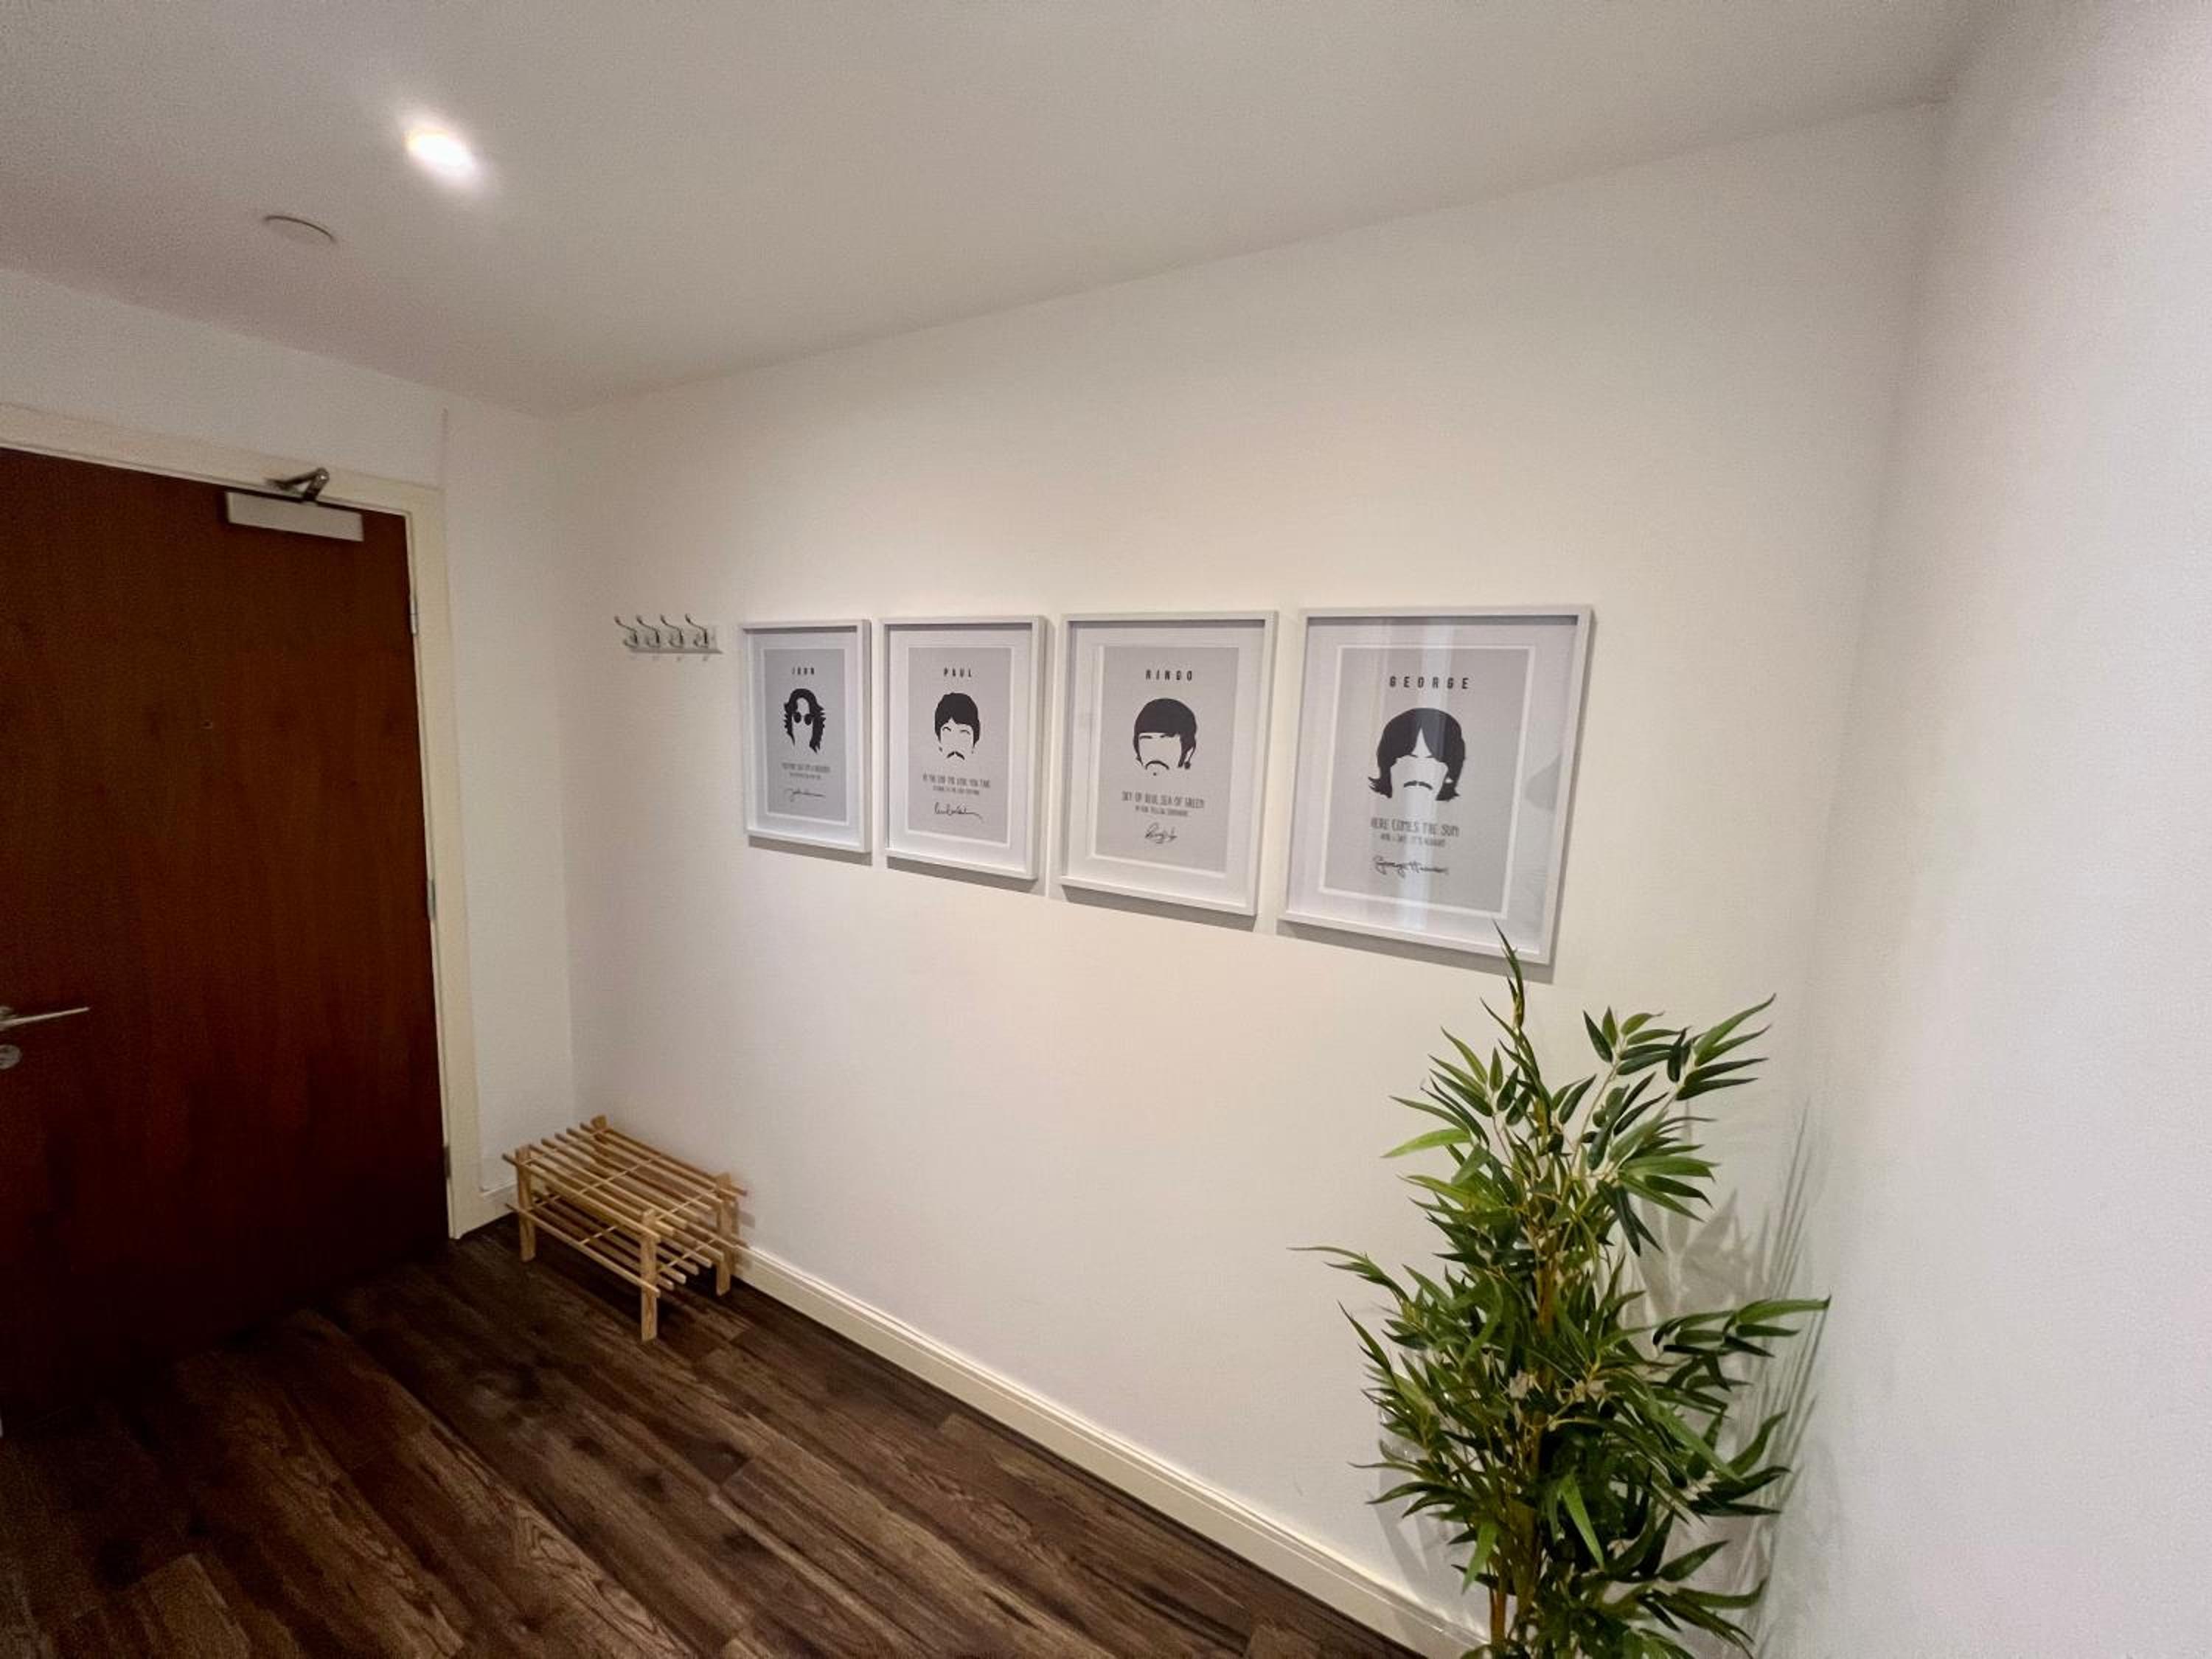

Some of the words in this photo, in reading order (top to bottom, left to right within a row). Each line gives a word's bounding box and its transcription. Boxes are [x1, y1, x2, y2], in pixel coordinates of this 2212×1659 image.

[943, 667, 972, 678] PAUL
[1146, 669, 1192, 681] RINGO
[1389, 675, 1470, 689] GEORGE
[1391, 818, 1419, 833] COMES
[1440, 824, 1460, 838] SUN
